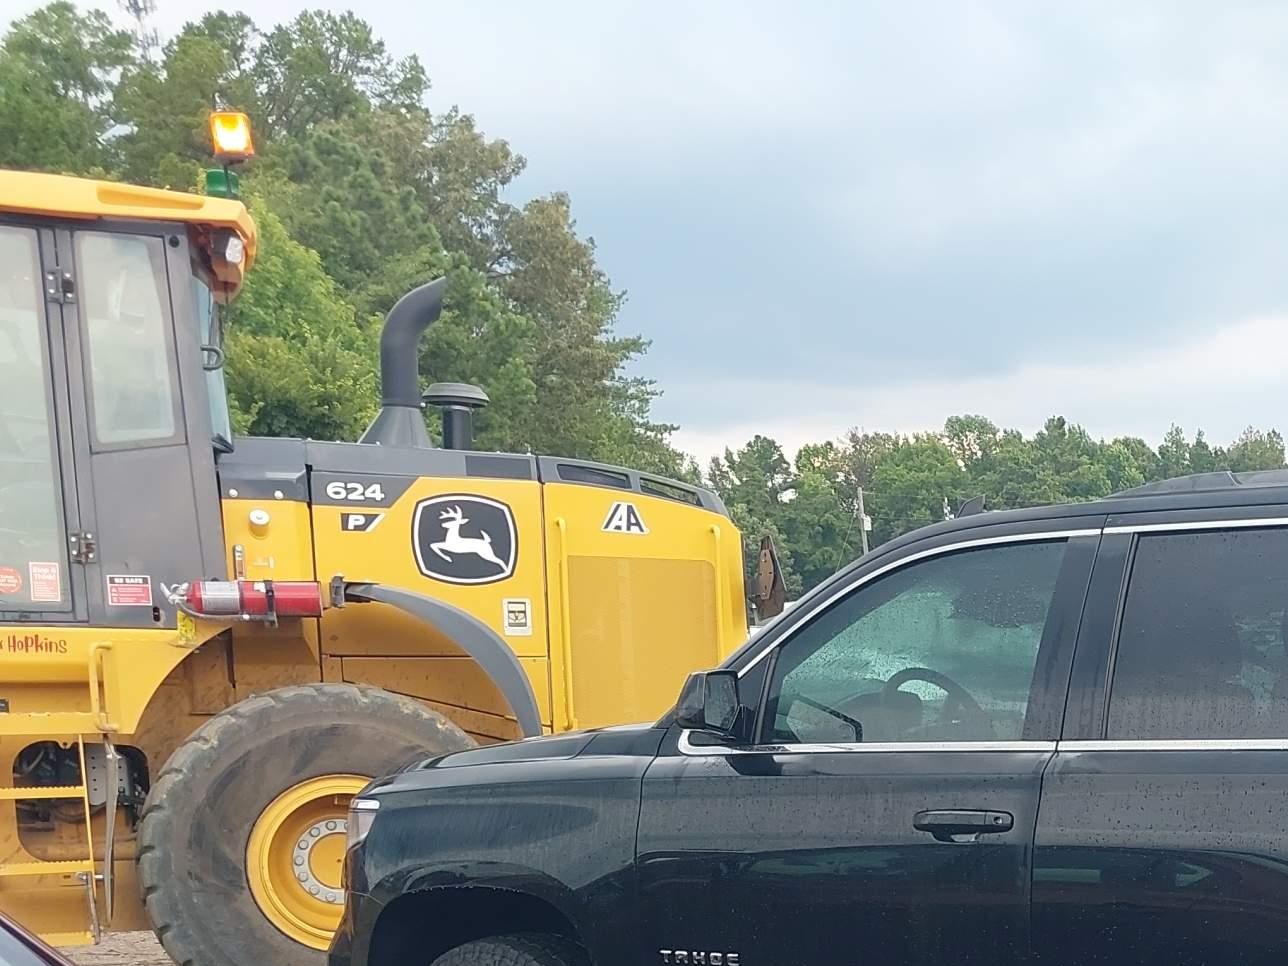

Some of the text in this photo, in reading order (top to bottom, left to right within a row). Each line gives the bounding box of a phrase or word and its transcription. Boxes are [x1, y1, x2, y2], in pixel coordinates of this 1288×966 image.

[326, 482, 385, 501] 624
[347, 514, 366, 530] P
[659, 949, 740, 966] TAHOE
